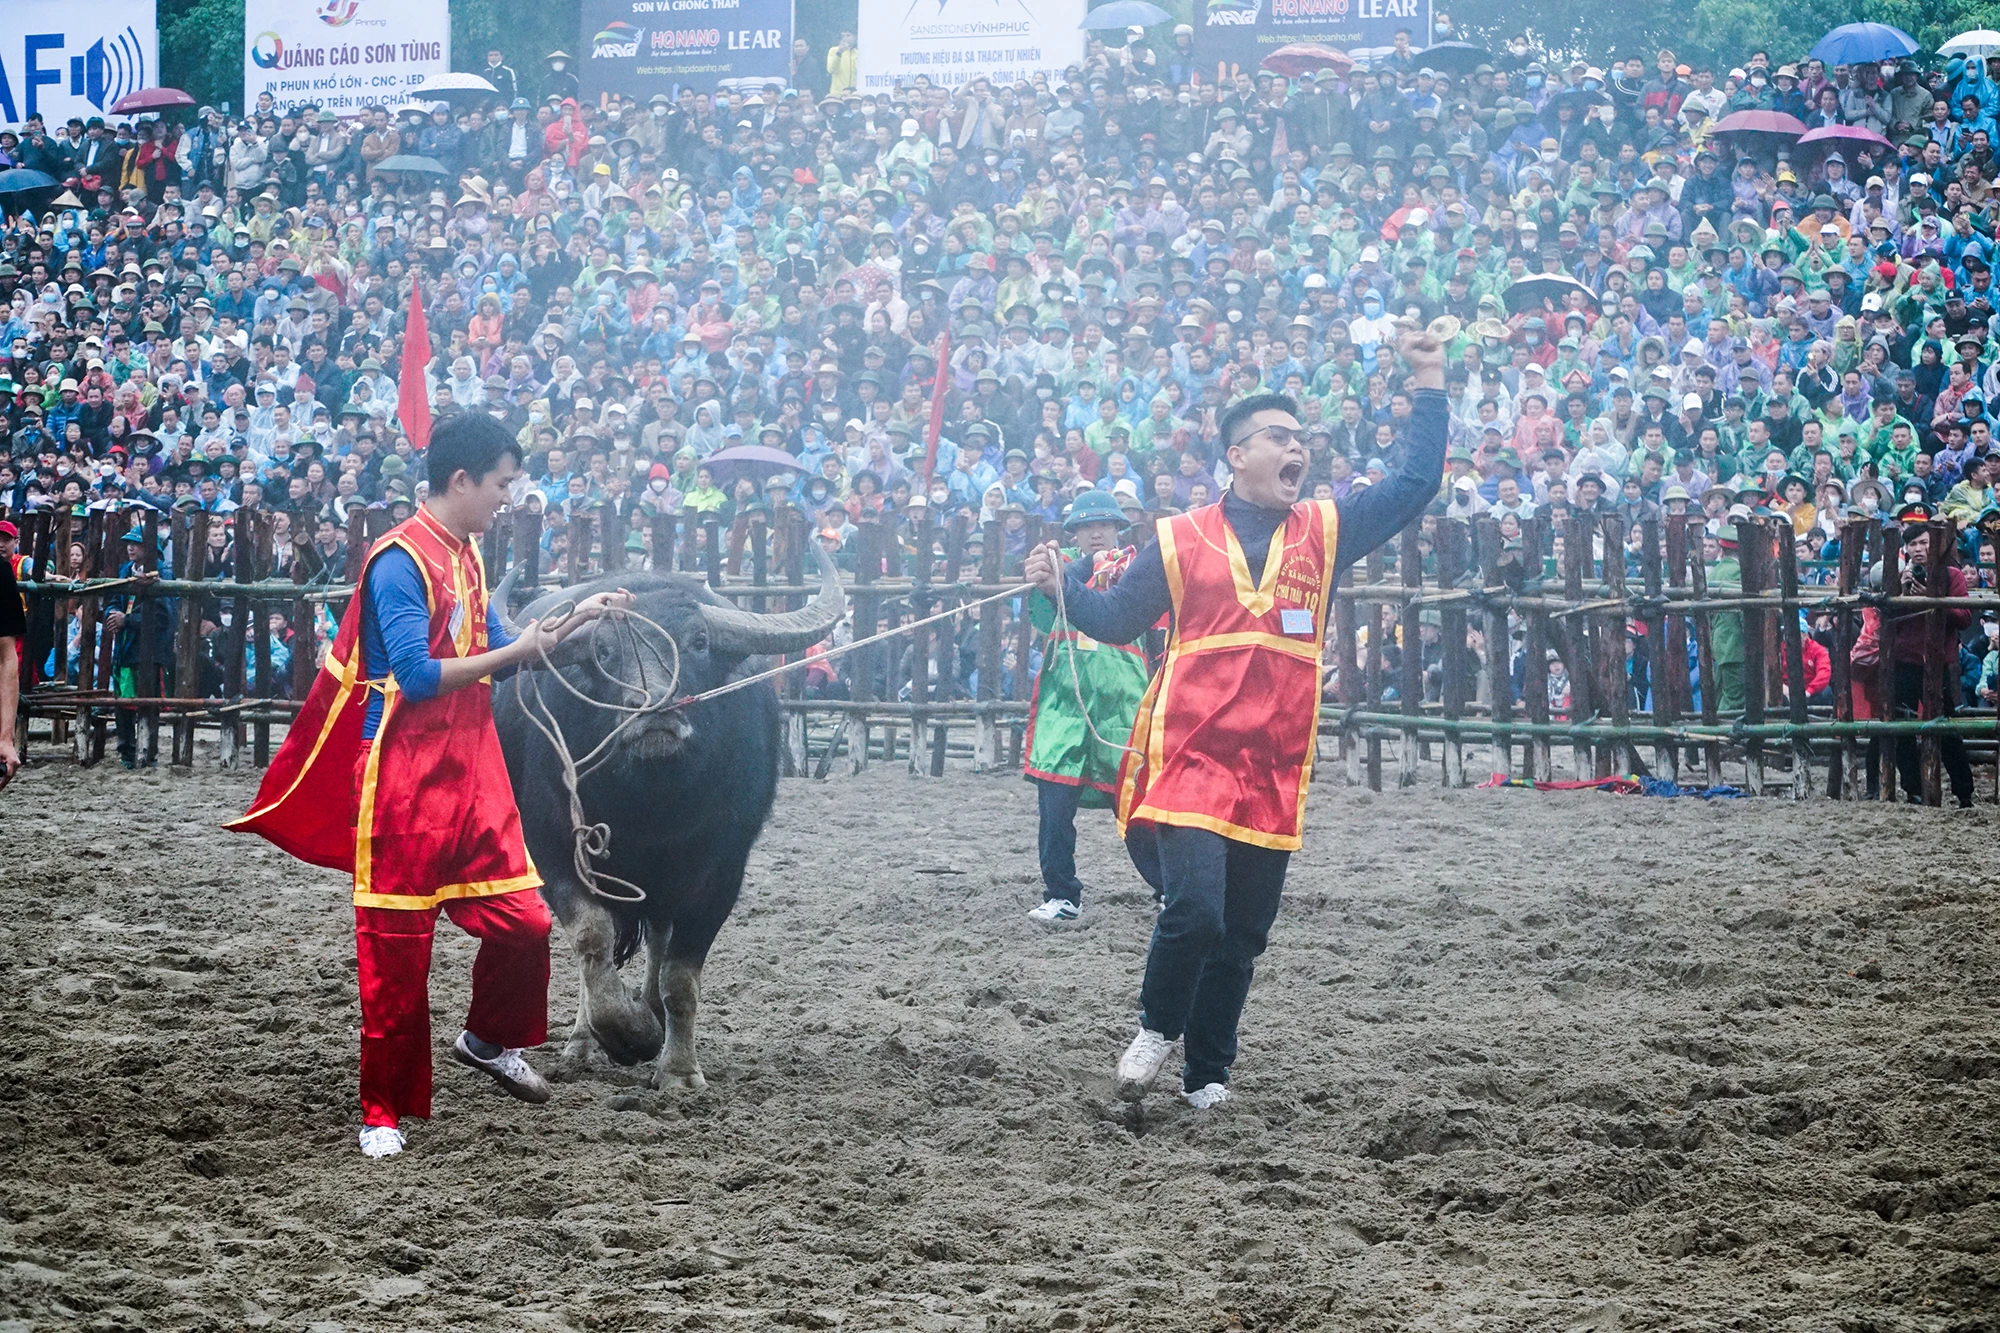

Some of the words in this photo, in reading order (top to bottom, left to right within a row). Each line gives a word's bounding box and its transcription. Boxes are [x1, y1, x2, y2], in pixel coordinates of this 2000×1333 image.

[1358, 0, 1418, 18] LEAR
[355, 18, 386, 28] Printing
[728, 29, 781, 50] LEAR
[252, 31, 325, 71] QUẢNG
[330, 43, 360, 66] CÁO
[365, 43, 396, 64] SƠN
[401, 39, 441, 62] TÙNG
[965, 51, 975, 63] SA
[266, 81, 277, 92] IN
[281, 79, 310, 91] PHUN
[313, 73, 337, 90] KHỔ
[340, 74, 362, 88] LỚN
[371, 75, 397, 87] CNC
[406, 74, 425, 86] LED
[327, 94, 353, 108] TRÊN
[381, 90, 411, 106] CHẤT
[1304, 590, 1318, 618] 19
